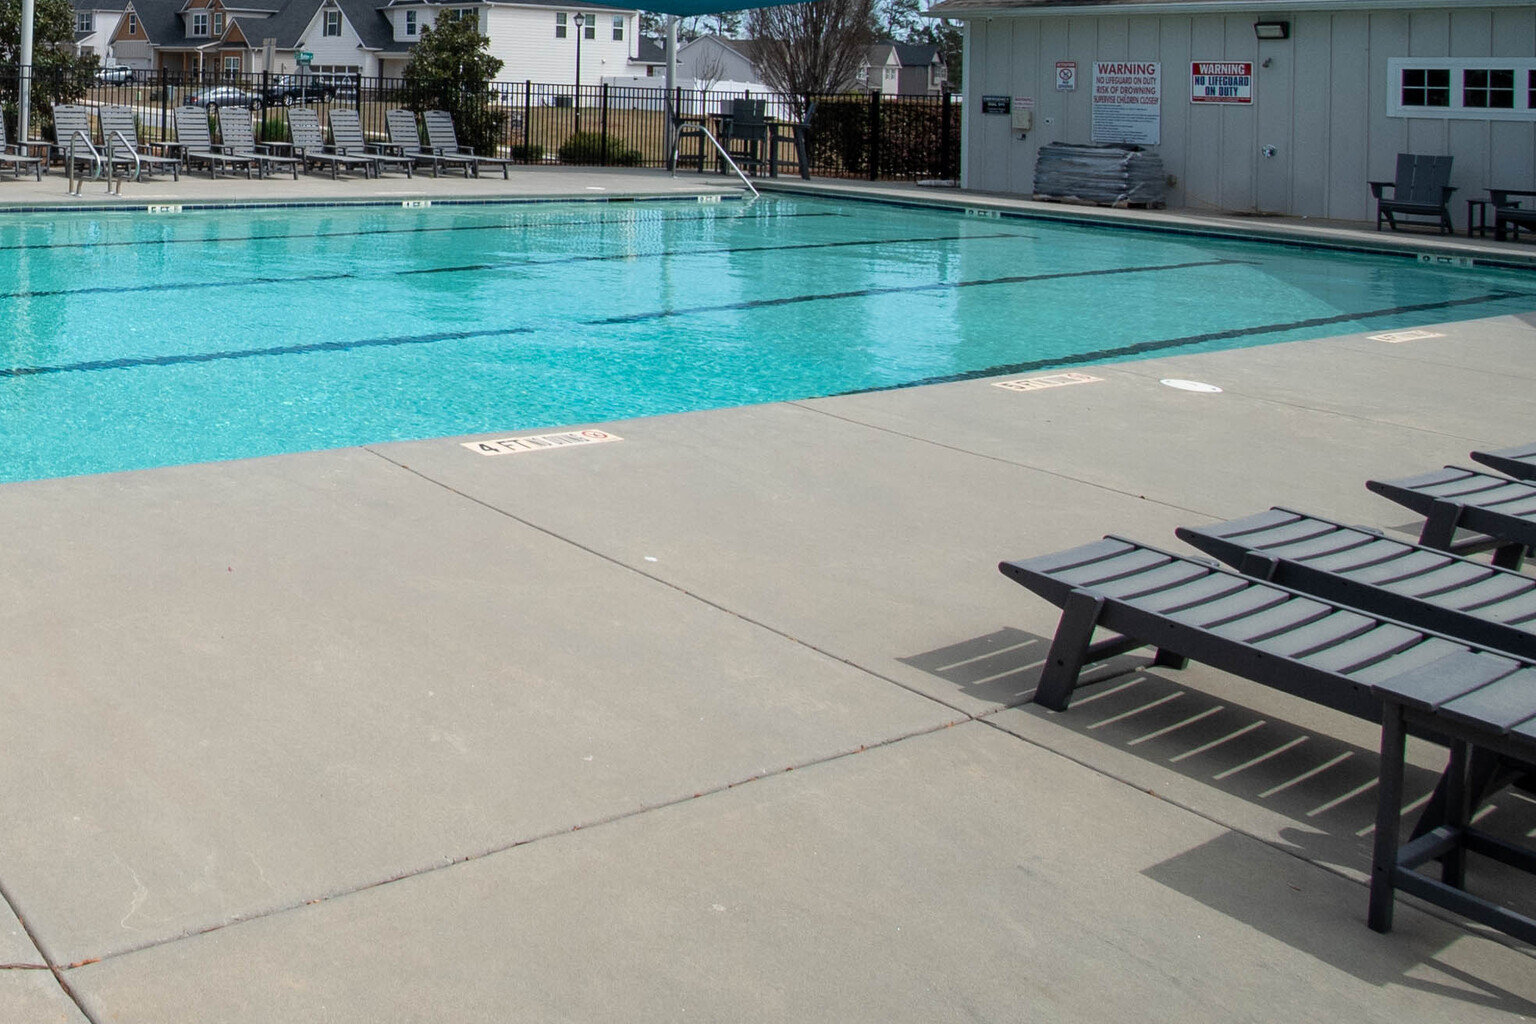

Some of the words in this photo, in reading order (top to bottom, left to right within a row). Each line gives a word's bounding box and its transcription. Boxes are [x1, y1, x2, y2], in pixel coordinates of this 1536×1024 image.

[1098, 63, 1155, 75] WARNING
[1199, 64, 1245, 74] WARNING
[1143, 77, 1156, 85] DUTY
[1194, 76, 1205, 85] NO
[1208, 76, 1249, 86] LIFEGUARD
[1096, 86, 1109, 94] RISK
[1110, 86, 1119, 94] OF
[1120, 86, 1156, 94] DROWNING
[1205, 86, 1216, 96] ON
[1218, 86, 1238, 96] DUTY
[478, 443, 500, 453] 4
[498, 439, 531, 451] FT
